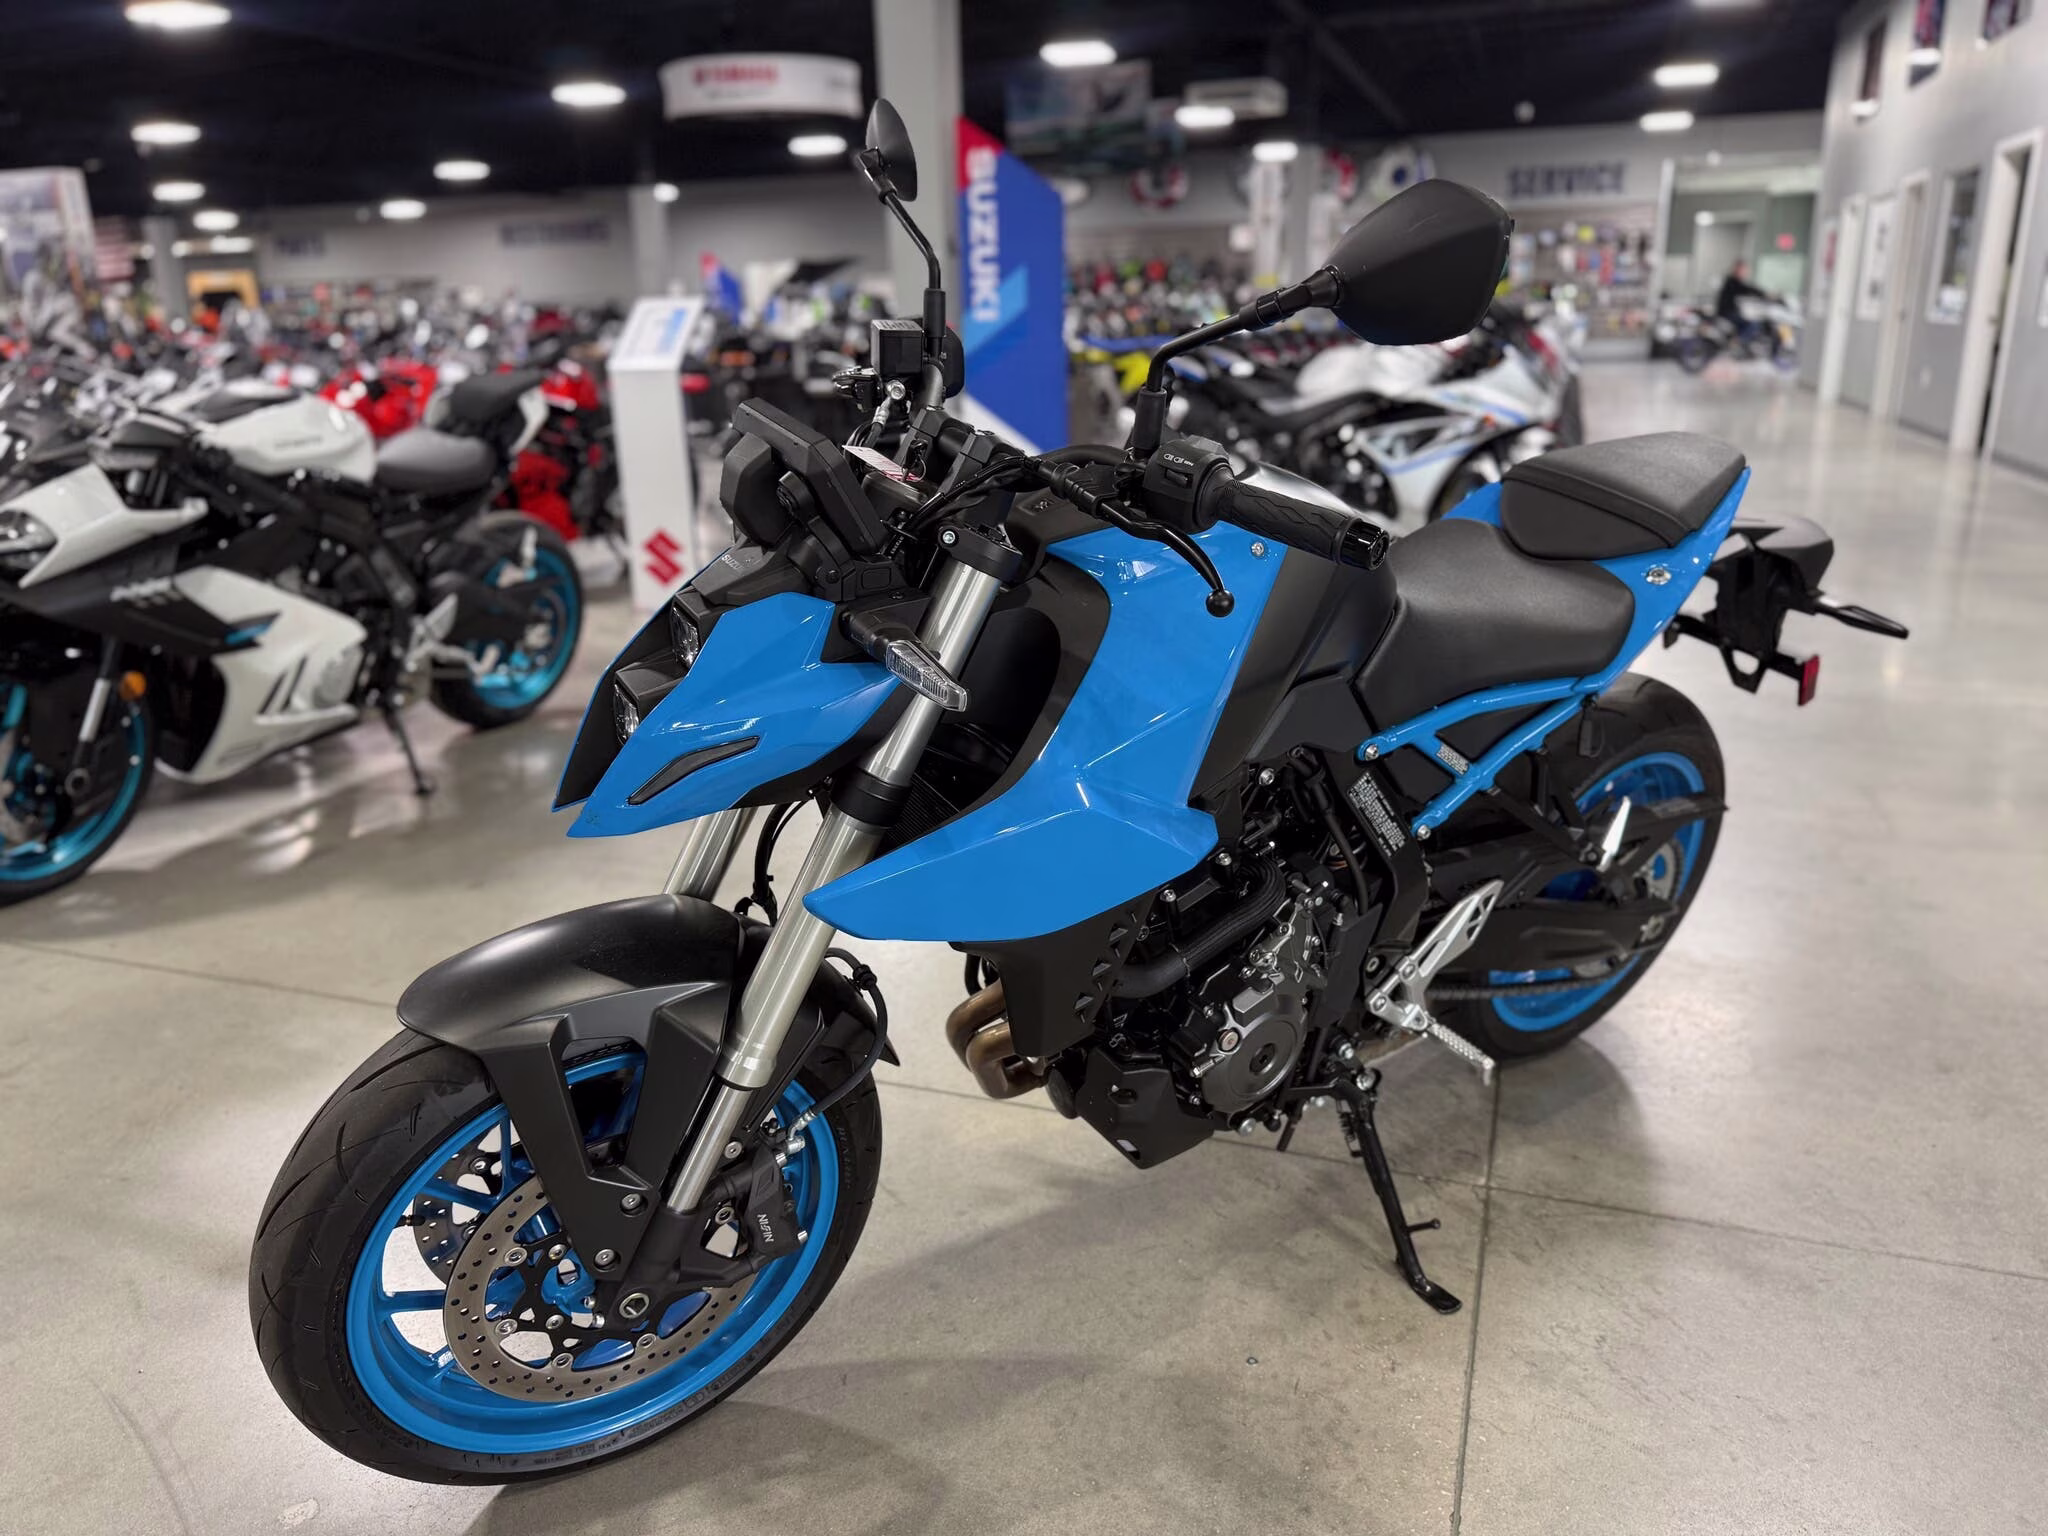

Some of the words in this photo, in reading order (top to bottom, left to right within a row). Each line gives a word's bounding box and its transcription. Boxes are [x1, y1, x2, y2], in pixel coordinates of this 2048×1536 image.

[1508, 162, 1625, 196] SERVICE
[966, 147, 1001, 321] SUZUKI
[757, 1214, 775, 1243] NISSIN
